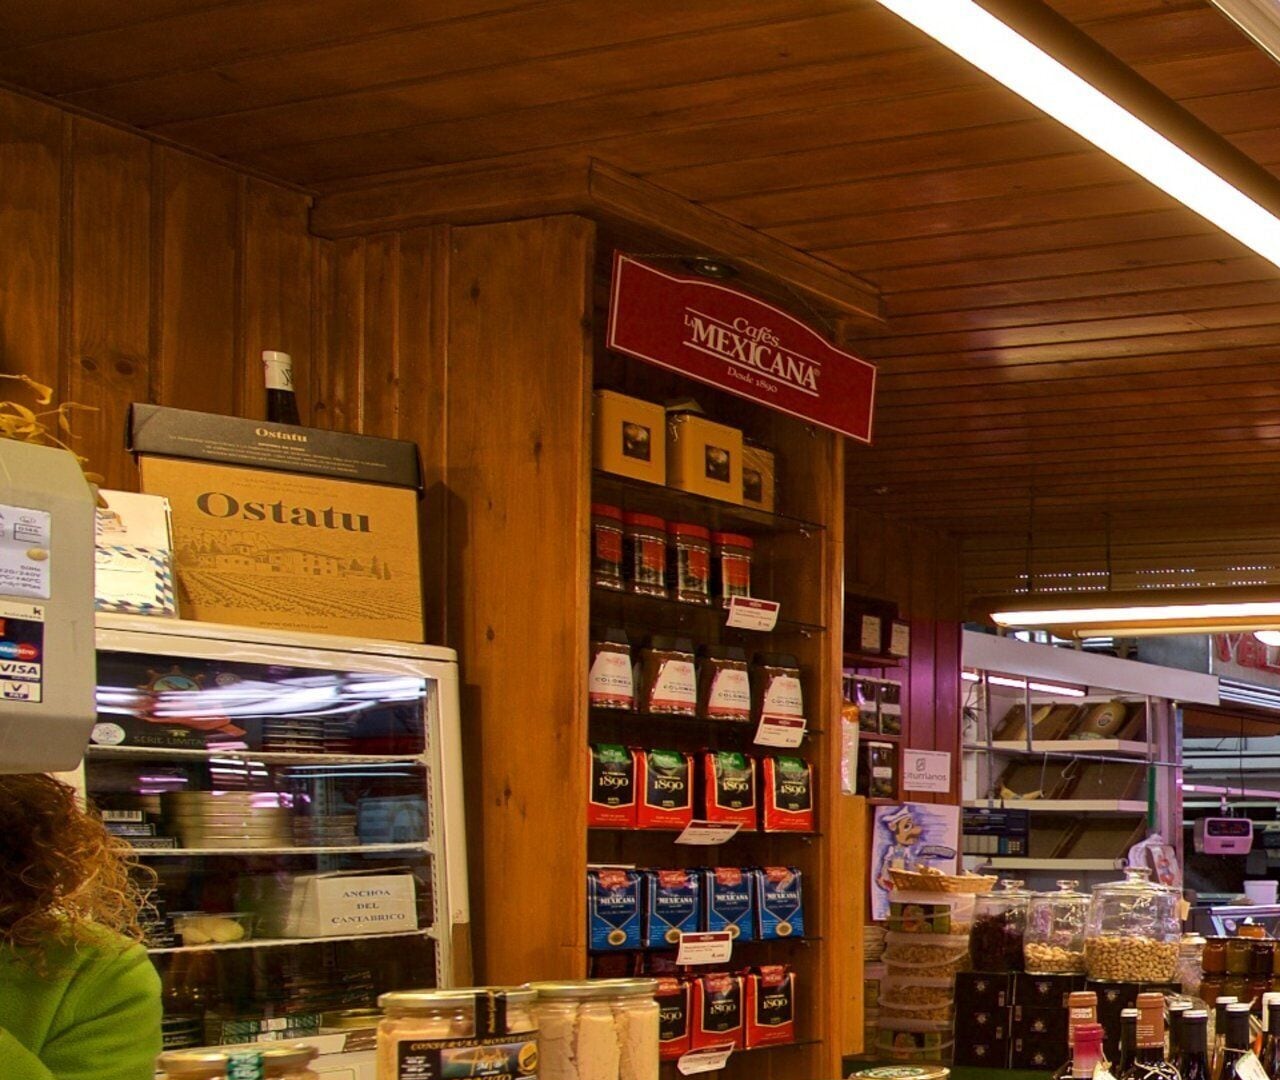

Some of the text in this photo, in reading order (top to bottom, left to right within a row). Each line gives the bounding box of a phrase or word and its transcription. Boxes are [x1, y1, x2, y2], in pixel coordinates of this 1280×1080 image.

[732, 317, 781, 348] Cafés
[692, 317, 818, 391] MEXICANA
[727, 366, 778, 393] Desde 1890
[255, 427, 308, 443] Ostatu
[196, 491, 373, 533] Ostatu
[1, 663, 38, 676] VISA
[599, 776, 628, 793] 1890
[654, 780, 683, 795] 1890
[723, 780, 749, 795] 1890
[781, 784, 806, 798] 1890
[343, 889, 392, 898] ANCHOA
[356, 902, 379, 910] DEL
[331, 912, 406, 925] CANTABRICO
[710, 1003, 736, 1016] 1890
[763, 998, 788, 1011] 1890
[411, 1039, 479, 1051] CONSERVAS
